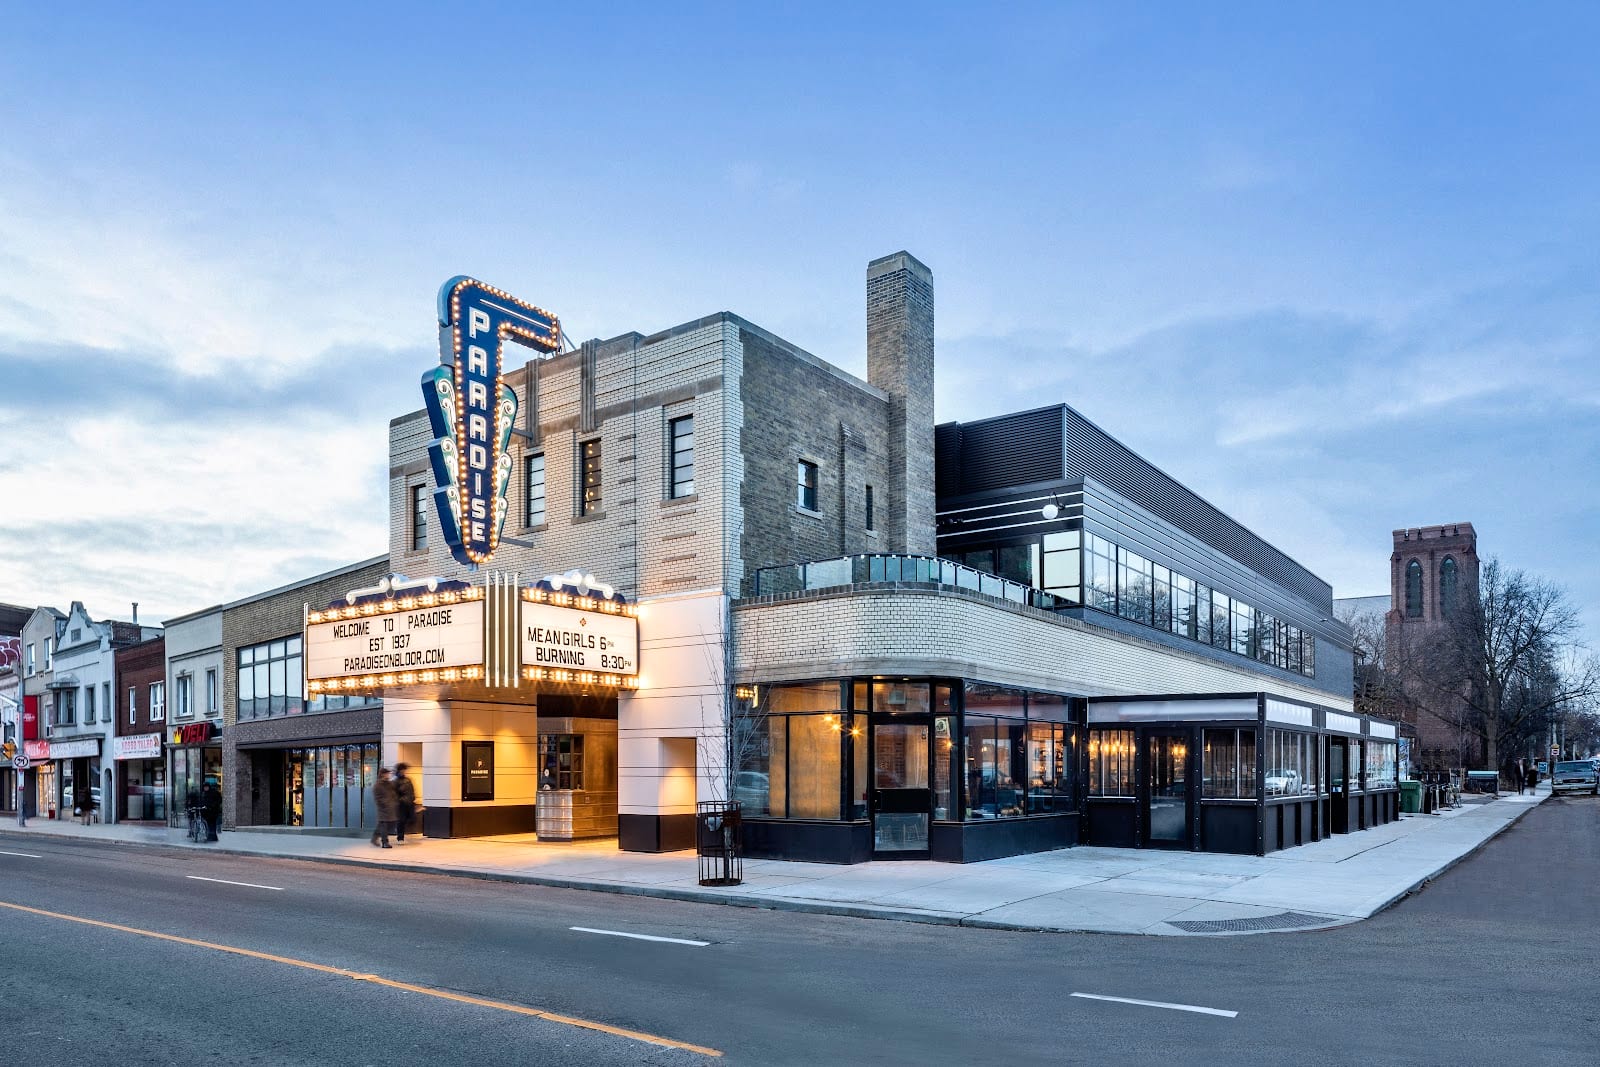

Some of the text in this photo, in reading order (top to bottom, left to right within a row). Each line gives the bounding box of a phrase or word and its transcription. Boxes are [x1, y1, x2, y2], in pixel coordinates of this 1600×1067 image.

[468, 306, 490, 542] PARADISE
[333, 609, 452, 638] WELCOME TO PARADISE
[369, 634, 411, 651] EST 1937
[344, 648, 445, 671] PARADISEONBLOOR.COM
[536, 646, 585, 665] BURNING
